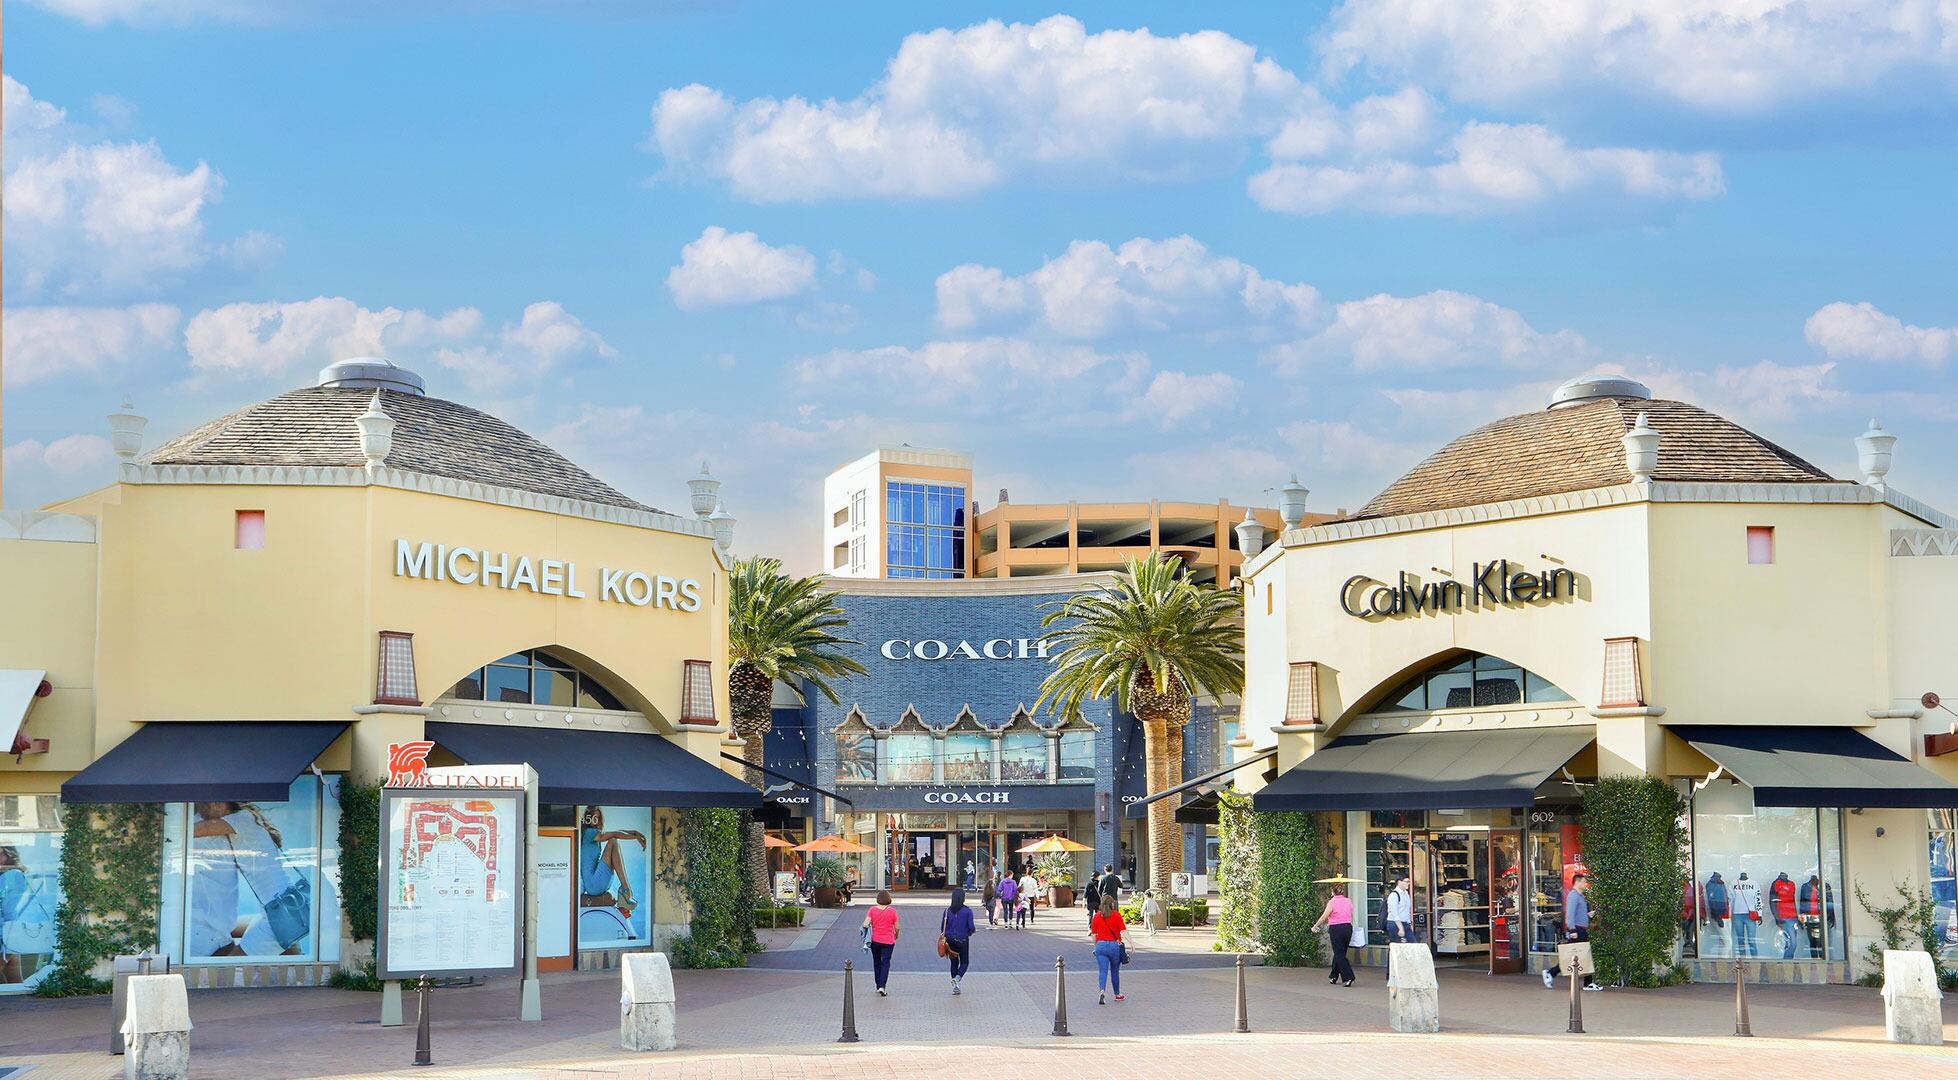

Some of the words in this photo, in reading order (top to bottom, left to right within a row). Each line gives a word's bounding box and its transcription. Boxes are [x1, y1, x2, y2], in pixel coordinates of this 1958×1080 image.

[395, 538, 586, 599] MICHAEL
[599, 566, 702, 613] KORS
[1340, 565, 1462, 618] Calvin
[1472, 553, 1575, 606] Klein
[880, 638, 1050, 660] COACH
[427, 775, 524, 788] CITADEL
[776, 796, 810, 804] OACH
[924, 792, 1010, 804] COACH
[581, 814, 599, 825] 456
[1531, 811, 1555, 822] 602
